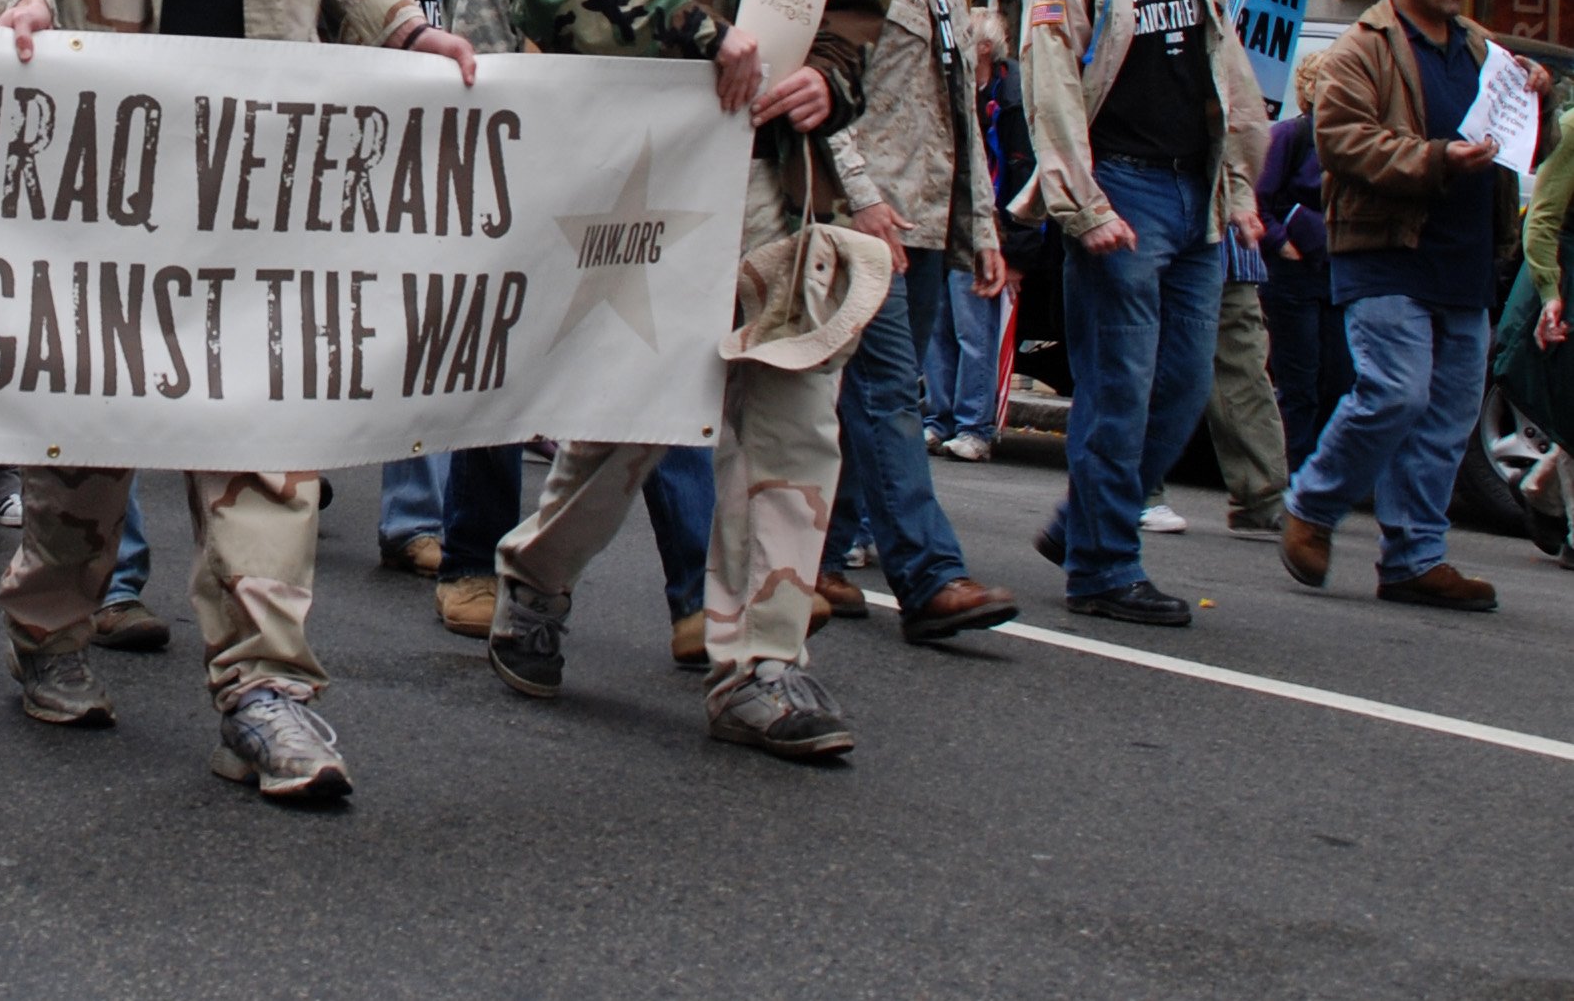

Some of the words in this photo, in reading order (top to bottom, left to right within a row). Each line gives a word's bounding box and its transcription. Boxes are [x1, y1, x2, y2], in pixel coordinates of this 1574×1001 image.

[193, 95, 522, 240] VETERANS
[576, 220, 666, 271] IVAW.ORG
[254, 268, 379, 401] THE
[400, 270, 529, 398] WAR
